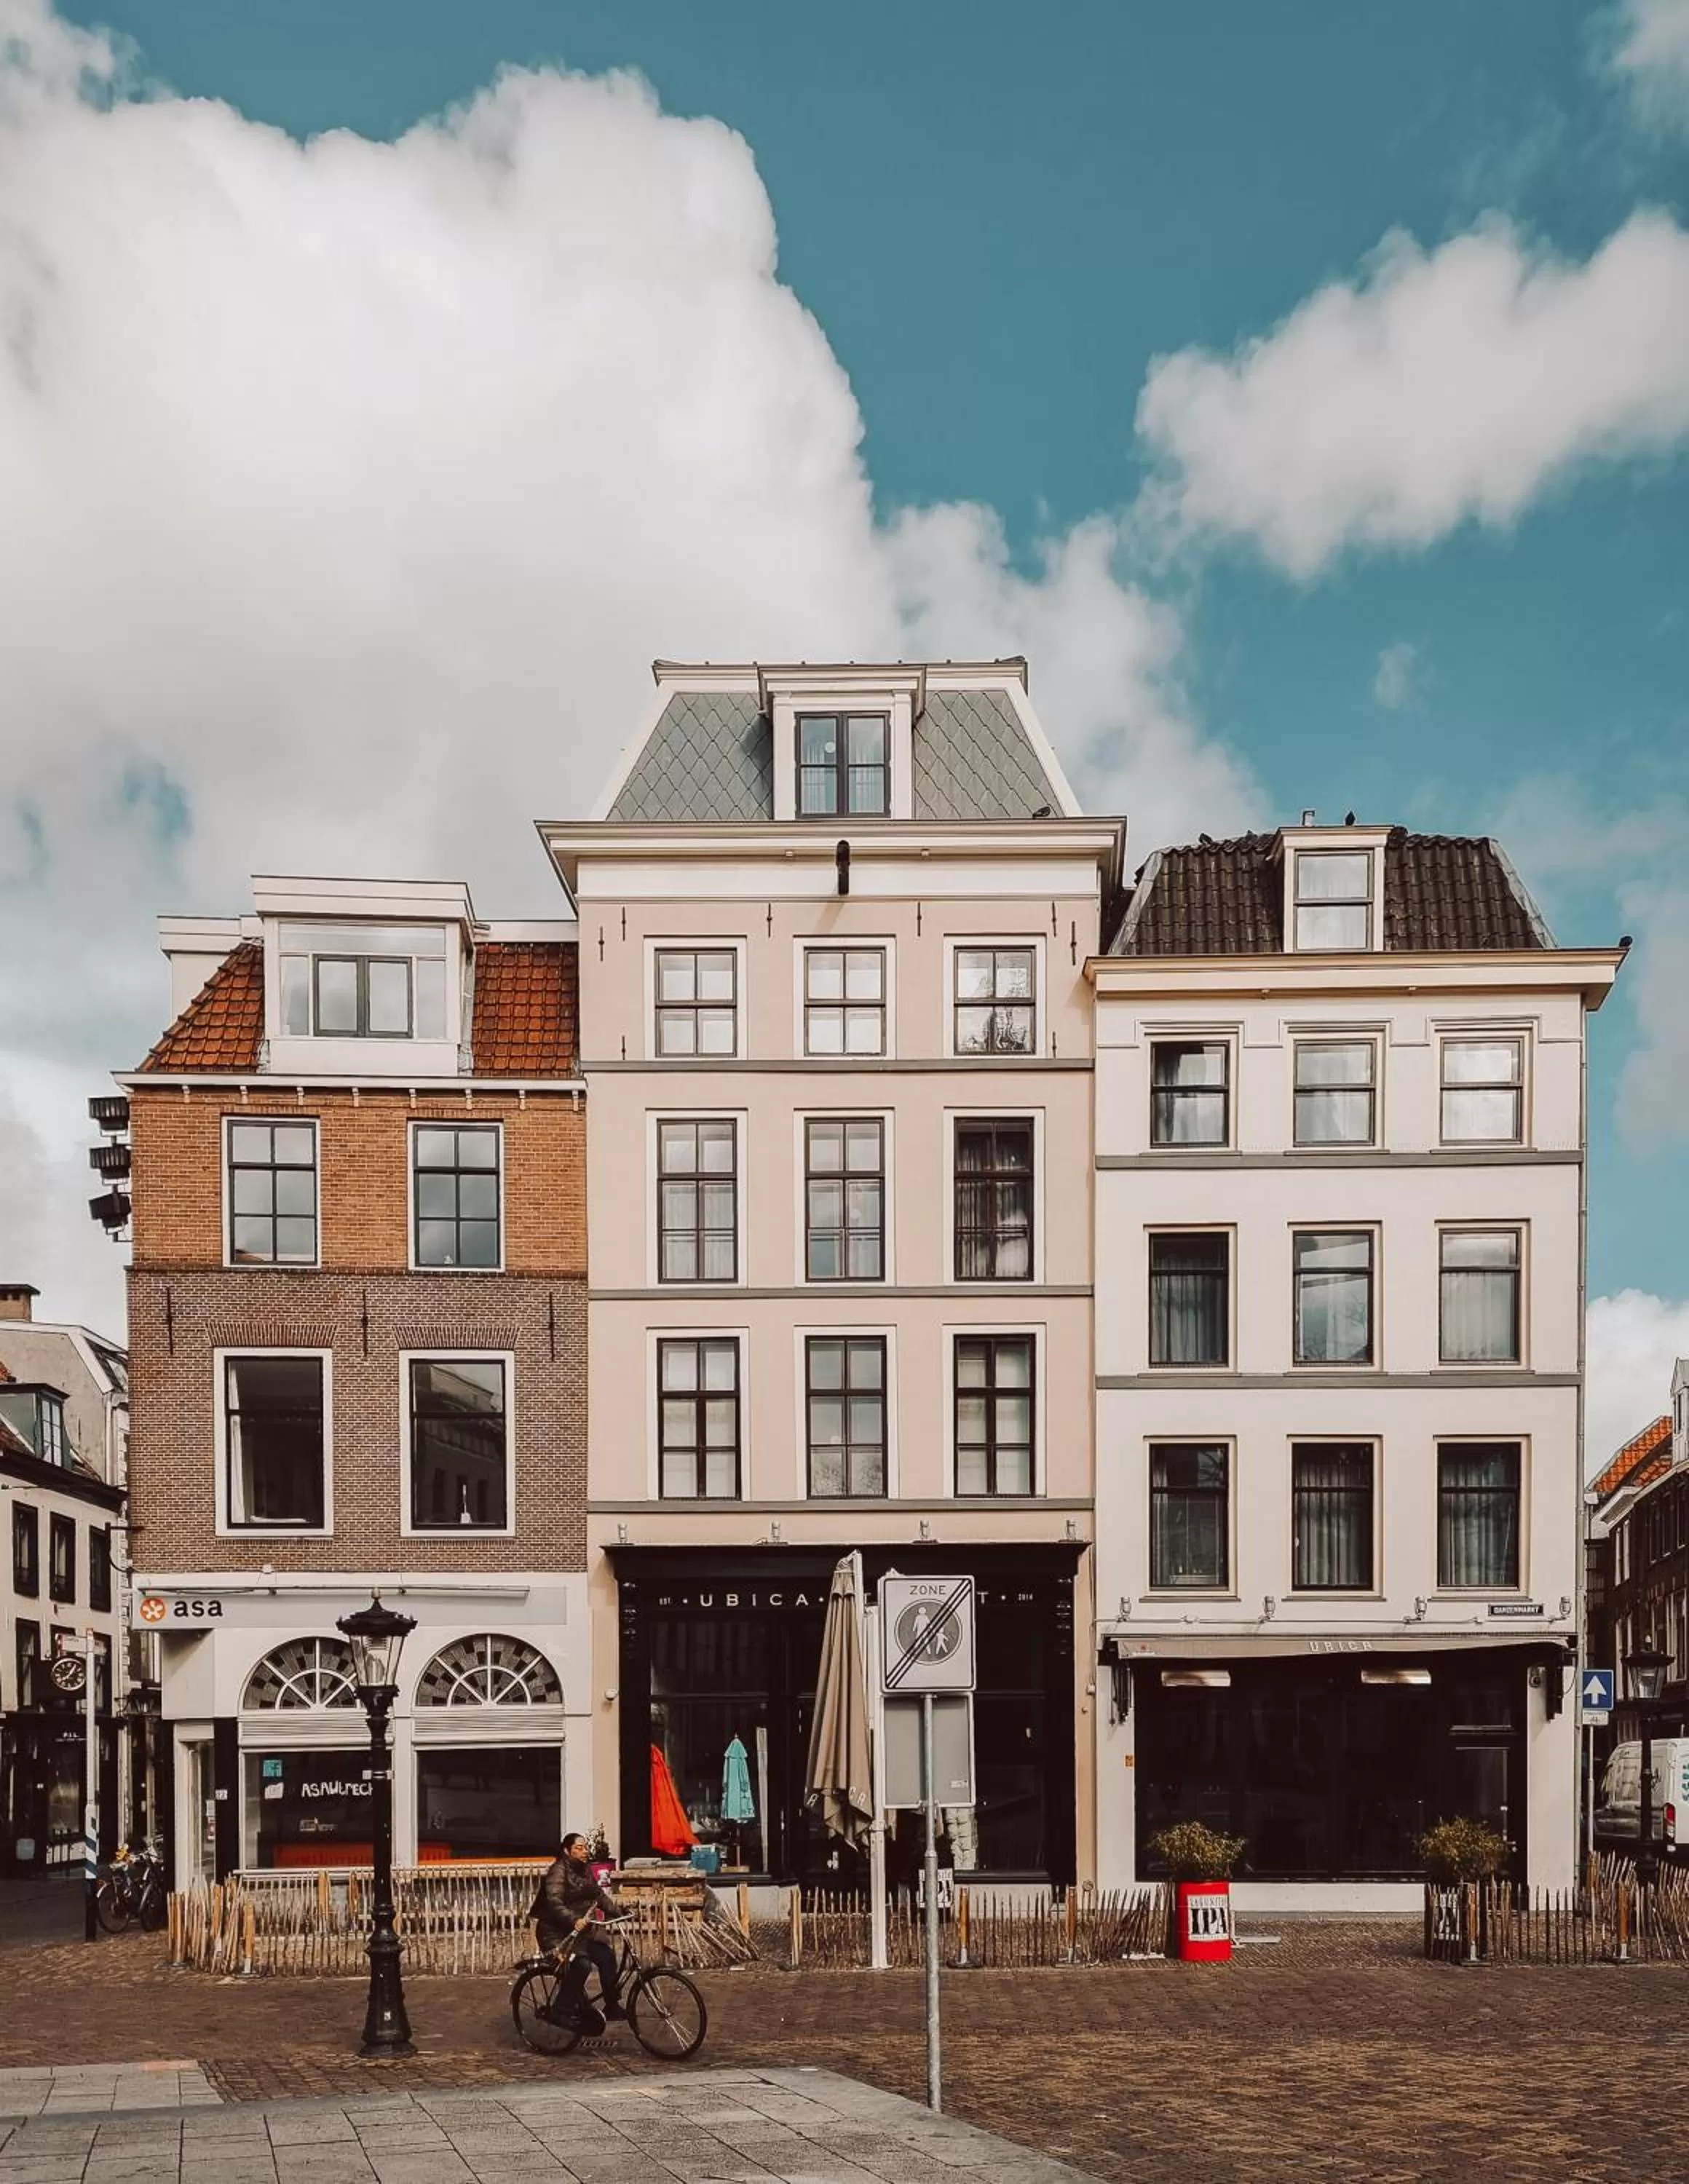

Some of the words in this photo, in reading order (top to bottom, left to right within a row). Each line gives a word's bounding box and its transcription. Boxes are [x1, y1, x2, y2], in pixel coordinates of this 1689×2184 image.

[909, 1585, 946, 1595] ZONE
[700, 1594, 808, 1607] UBICA
[173, 1600, 223, 1617] asa
[1191, 1907, 1227, 1934] IPA
